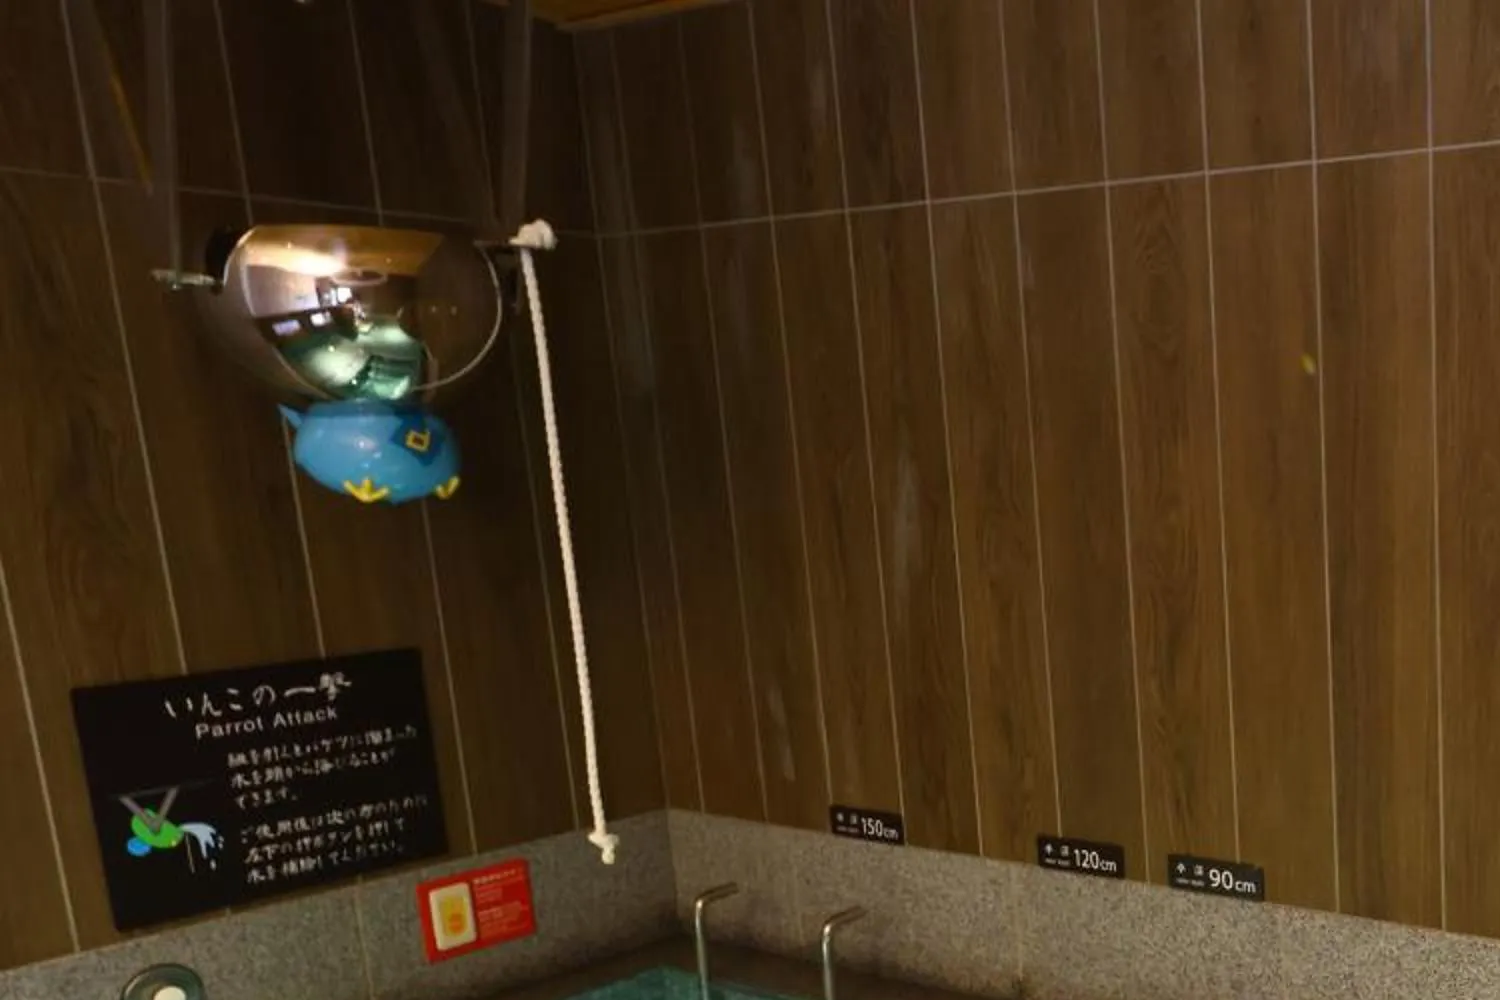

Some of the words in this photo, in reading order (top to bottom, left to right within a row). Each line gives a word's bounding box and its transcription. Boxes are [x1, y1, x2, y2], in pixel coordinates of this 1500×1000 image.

[195, 718, 264, 740] Parrot
[273, 705, 338, 728] Attack
[861, 816, 899, 840] 150cm
[1073, 848, 1117, 873] 120cm
[1209, 868, 1256, 893] 90cm
